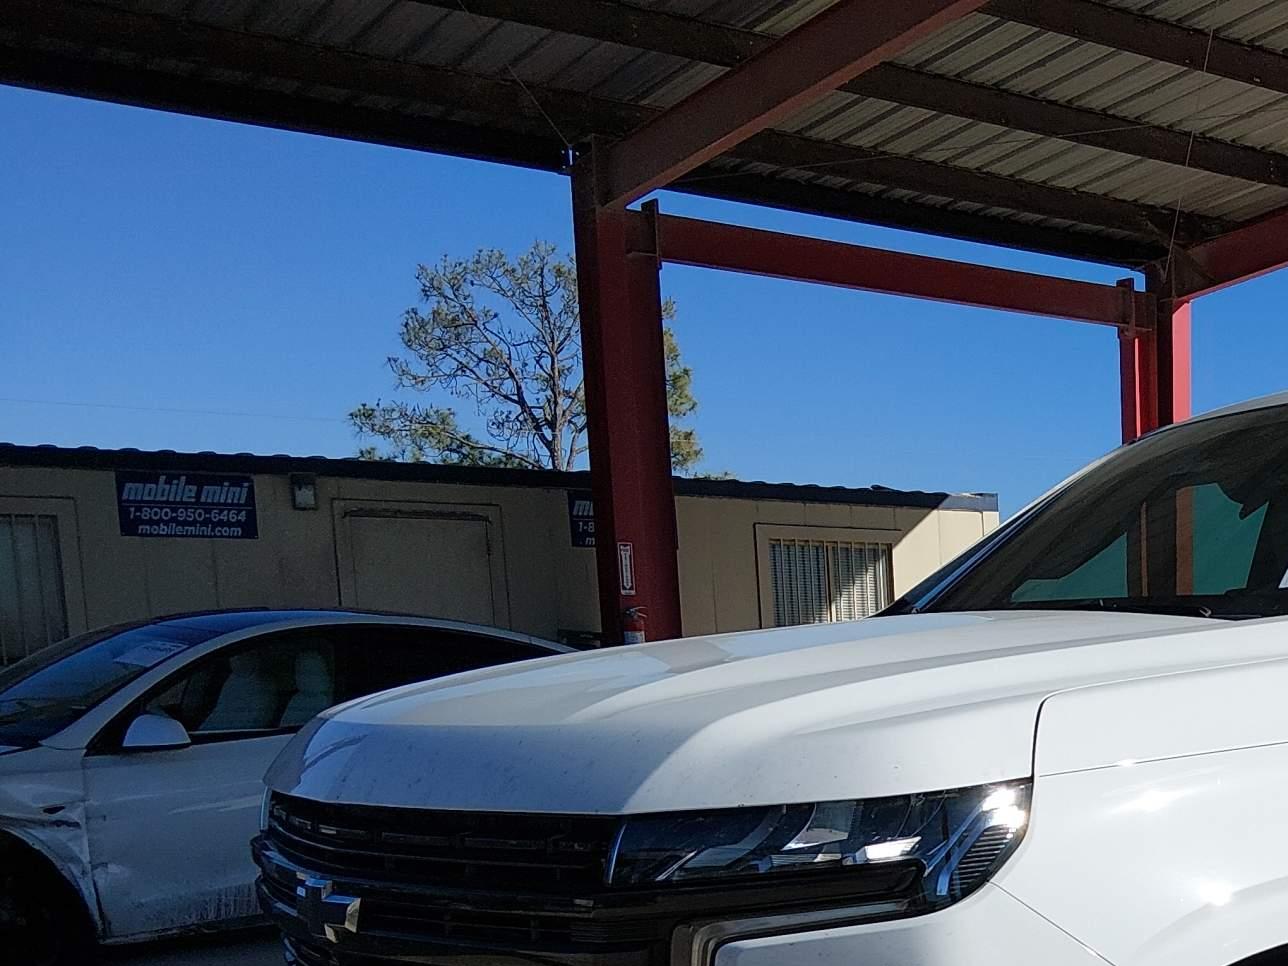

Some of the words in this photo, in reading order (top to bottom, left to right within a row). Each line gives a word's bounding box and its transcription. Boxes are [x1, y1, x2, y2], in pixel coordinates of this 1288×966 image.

[122, 475, 198, 501] mobile
[200, 482, 249, 503] mini
[129, 507, 247, 521] 1-800-950-6464
[138, 523, 242, 536] mobilemini.com
